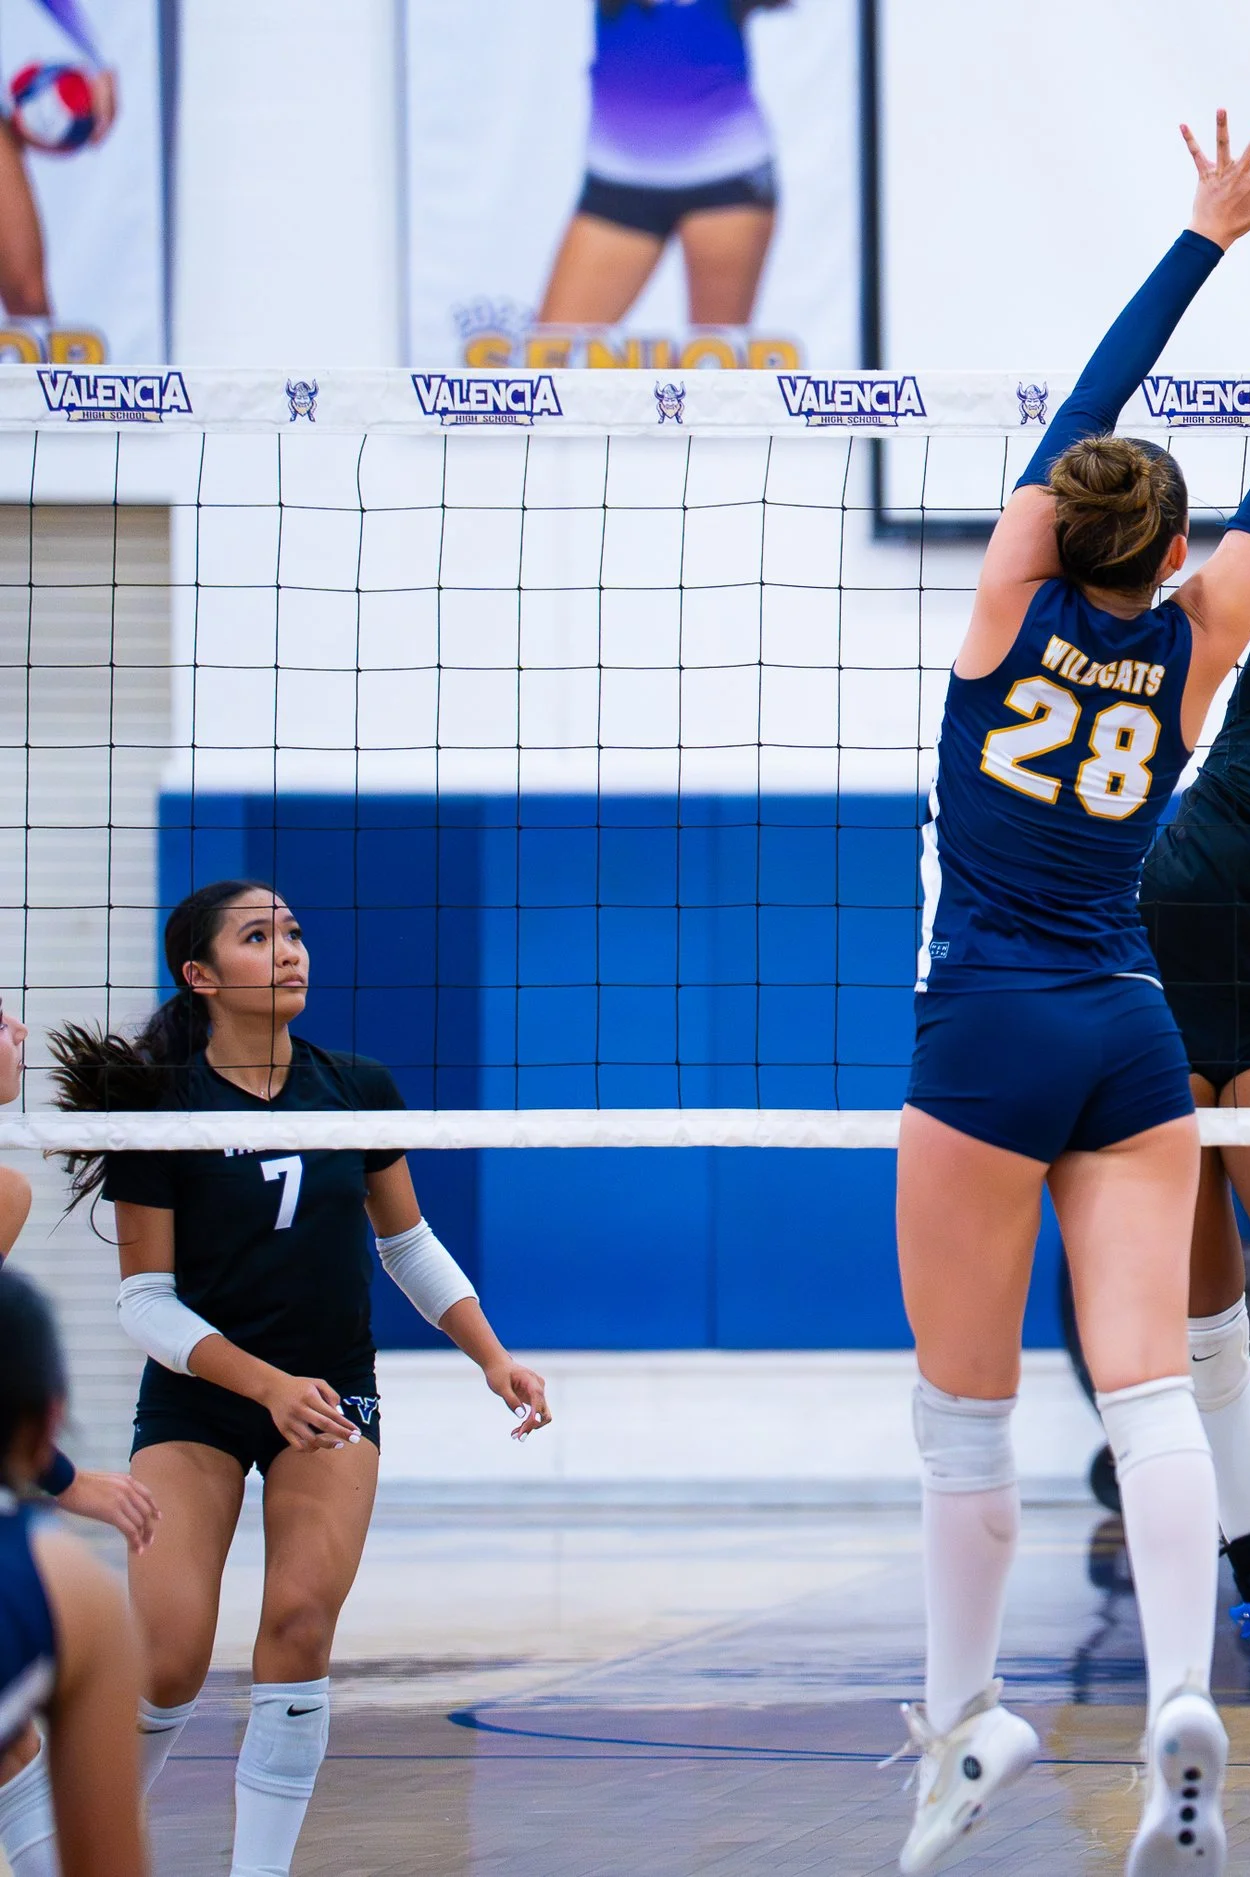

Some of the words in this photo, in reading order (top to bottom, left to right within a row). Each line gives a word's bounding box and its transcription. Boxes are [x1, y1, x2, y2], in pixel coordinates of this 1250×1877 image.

[466, 337, 800, 368] SENIOR
[36, 370, 193, 413] VALENCIA
[411, 375, 563, 415] VALENCIA
[777, 376, 927, 416] VALENCIA
[483, 415, 518, 423] SCHOOL
[1041, 634, 1166, 697] WILDCATS
[979, 675, 1162, 821] 28
[260, 1155, 303, 1231] 7
